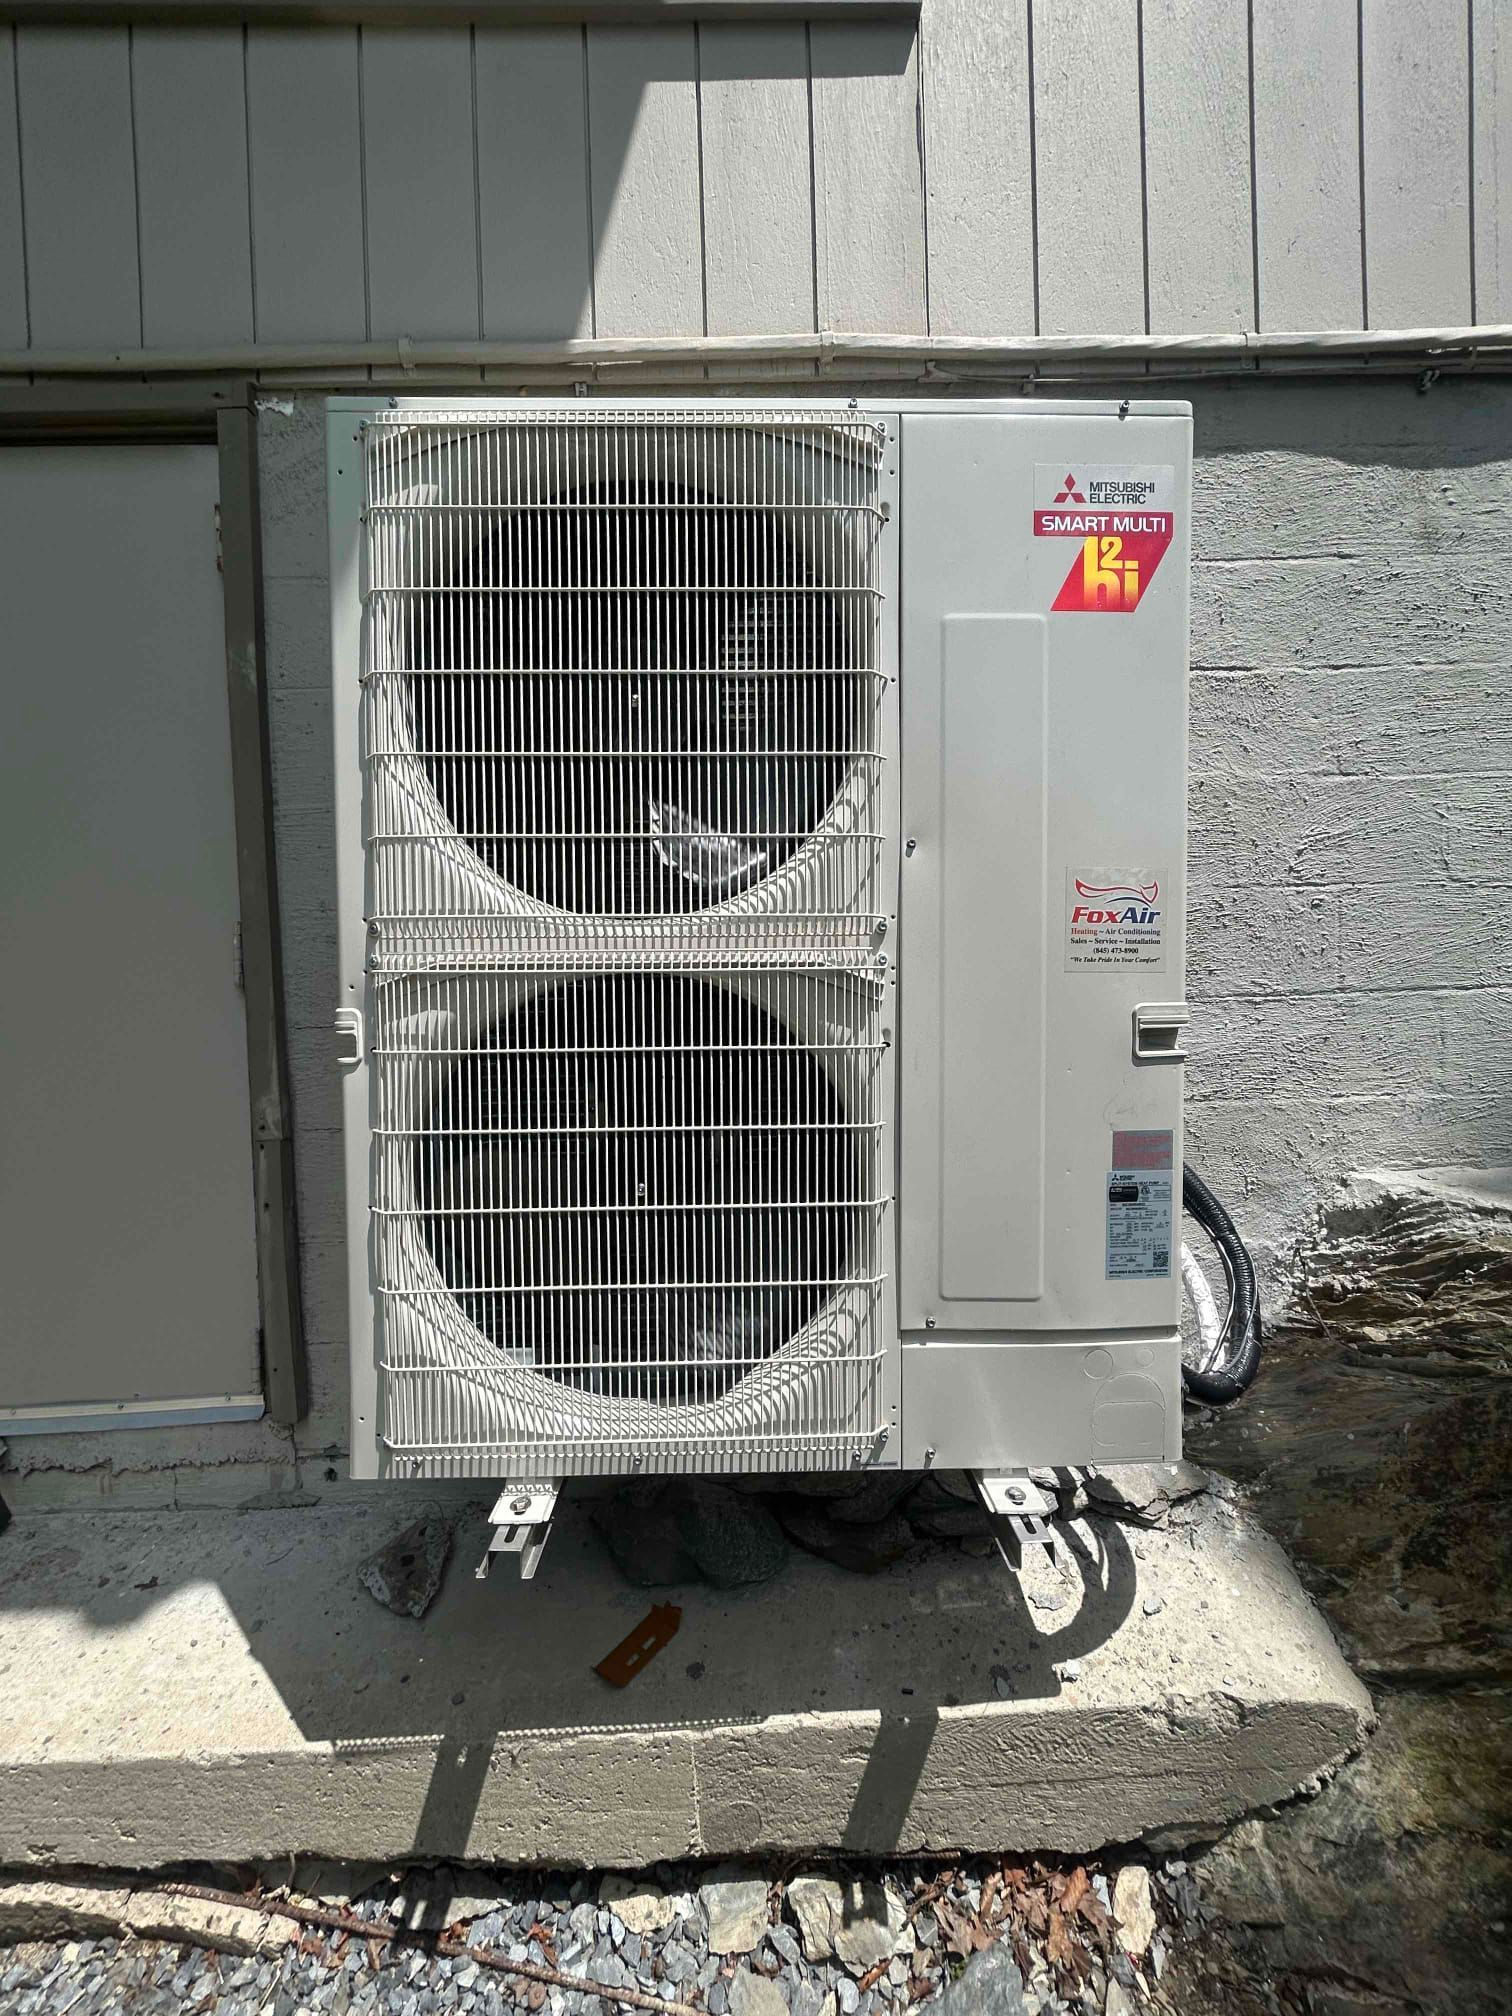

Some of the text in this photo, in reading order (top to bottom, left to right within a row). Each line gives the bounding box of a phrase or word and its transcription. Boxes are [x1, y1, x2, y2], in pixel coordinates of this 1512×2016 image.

[1089, 481, 1155, 493] MITSUBISHI
[1089, 493, 1146, 504] ELECTRIC
[1042, 516, 1166, 533] SMART MULTI
[1071, 906, 1161, 923] FoxAir
[1071, 928, 1098, 936] Heating
[1118, 928, 1161, 936] Conditioning
